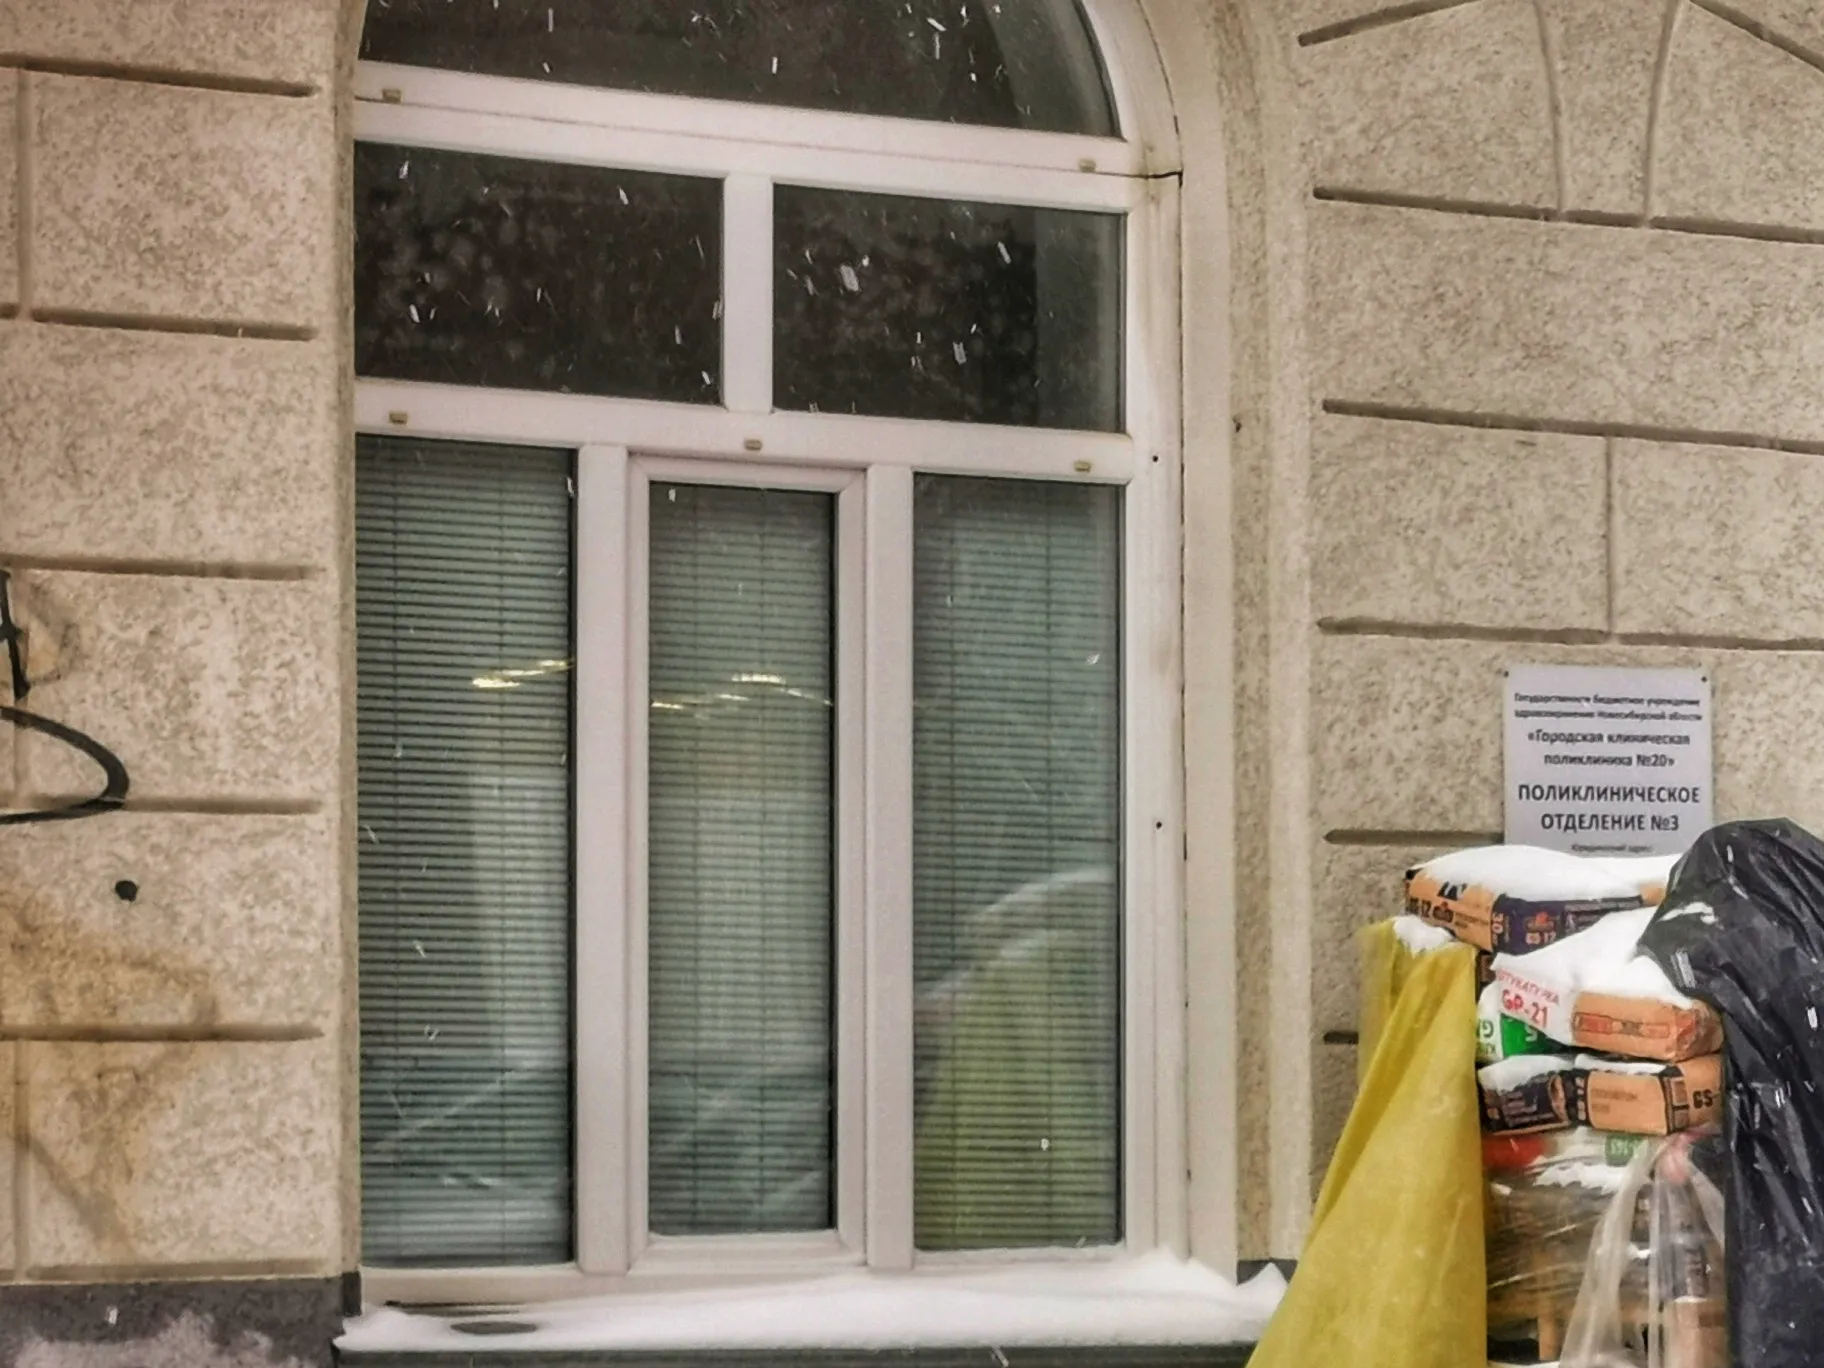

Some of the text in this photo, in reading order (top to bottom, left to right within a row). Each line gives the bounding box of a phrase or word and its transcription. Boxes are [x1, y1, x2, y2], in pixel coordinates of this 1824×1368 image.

[1527, 729, 1691, 746] «Городская клиническая
[1543, 753, 1676, 768] поликлиника №20»
[1518, 783, 1701, 804] ПОЛИКЛИНИЧЕСКОЕ
[1541, 813, 1680, 833] ОТДЕЛЕНИЕ №3
